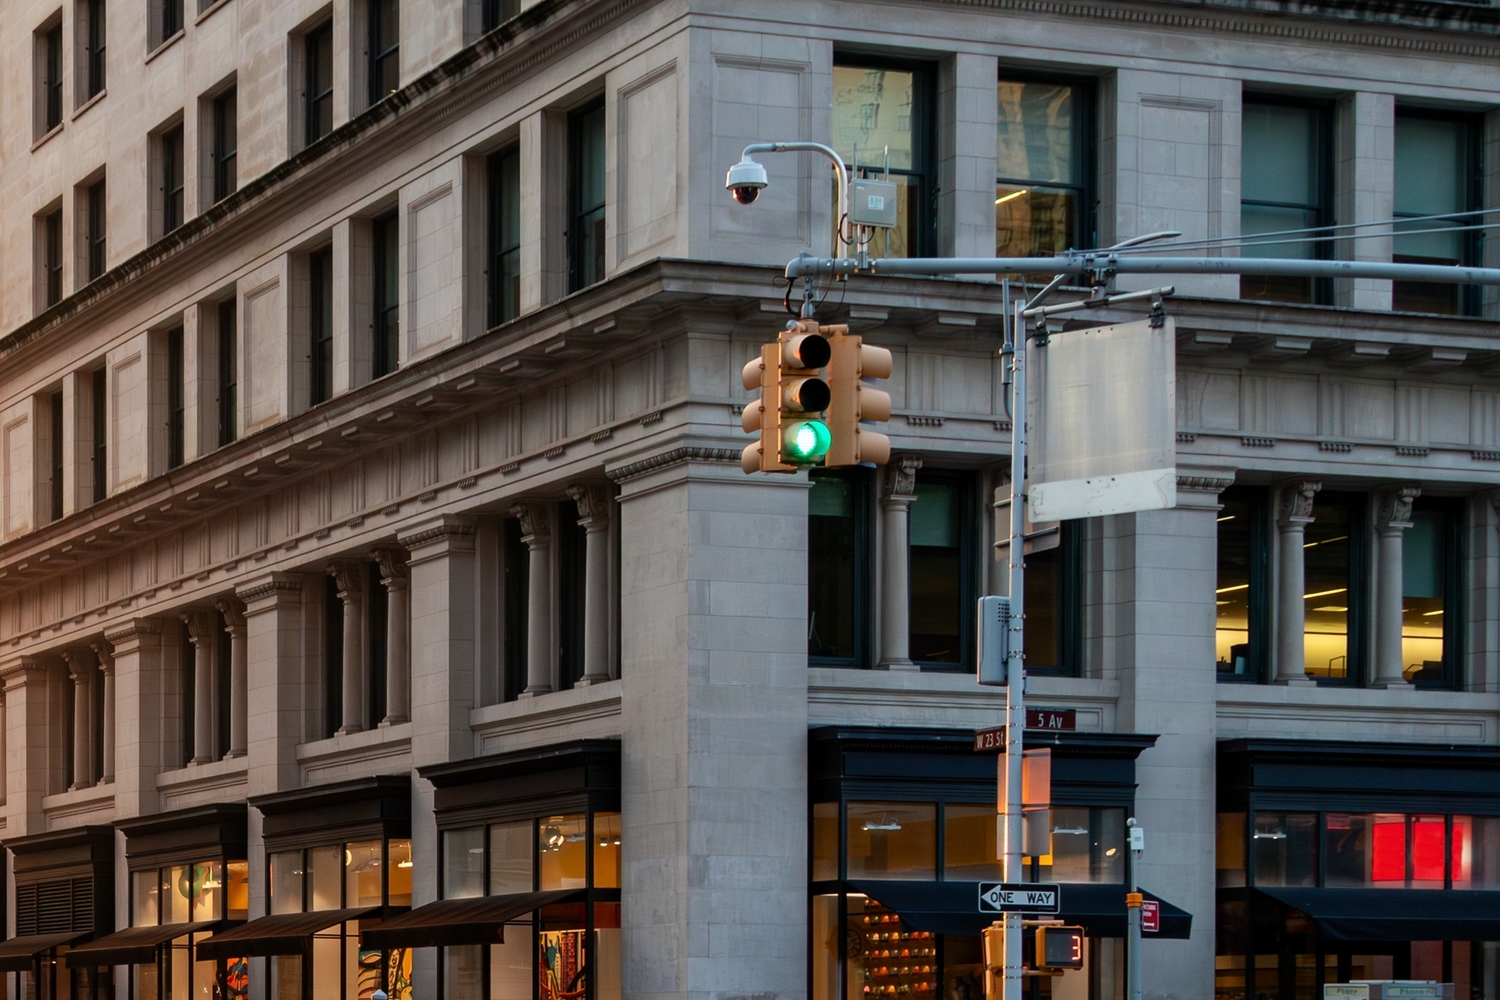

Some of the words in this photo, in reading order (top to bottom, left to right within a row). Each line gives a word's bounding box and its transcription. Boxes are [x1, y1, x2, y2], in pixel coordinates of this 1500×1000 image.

[1038, 713, 1044, 727] 5
[1048, 714, 1063, 728] Av
[976, 734, 984, 749] W
[985, 733, 994, 748] 23
[996, 731, 1004, 746] St
[990, 892, 1014, 903] ONE
[1027, 892, 1052, 904] WAY
[1071, 935, 1081, 961] 3
